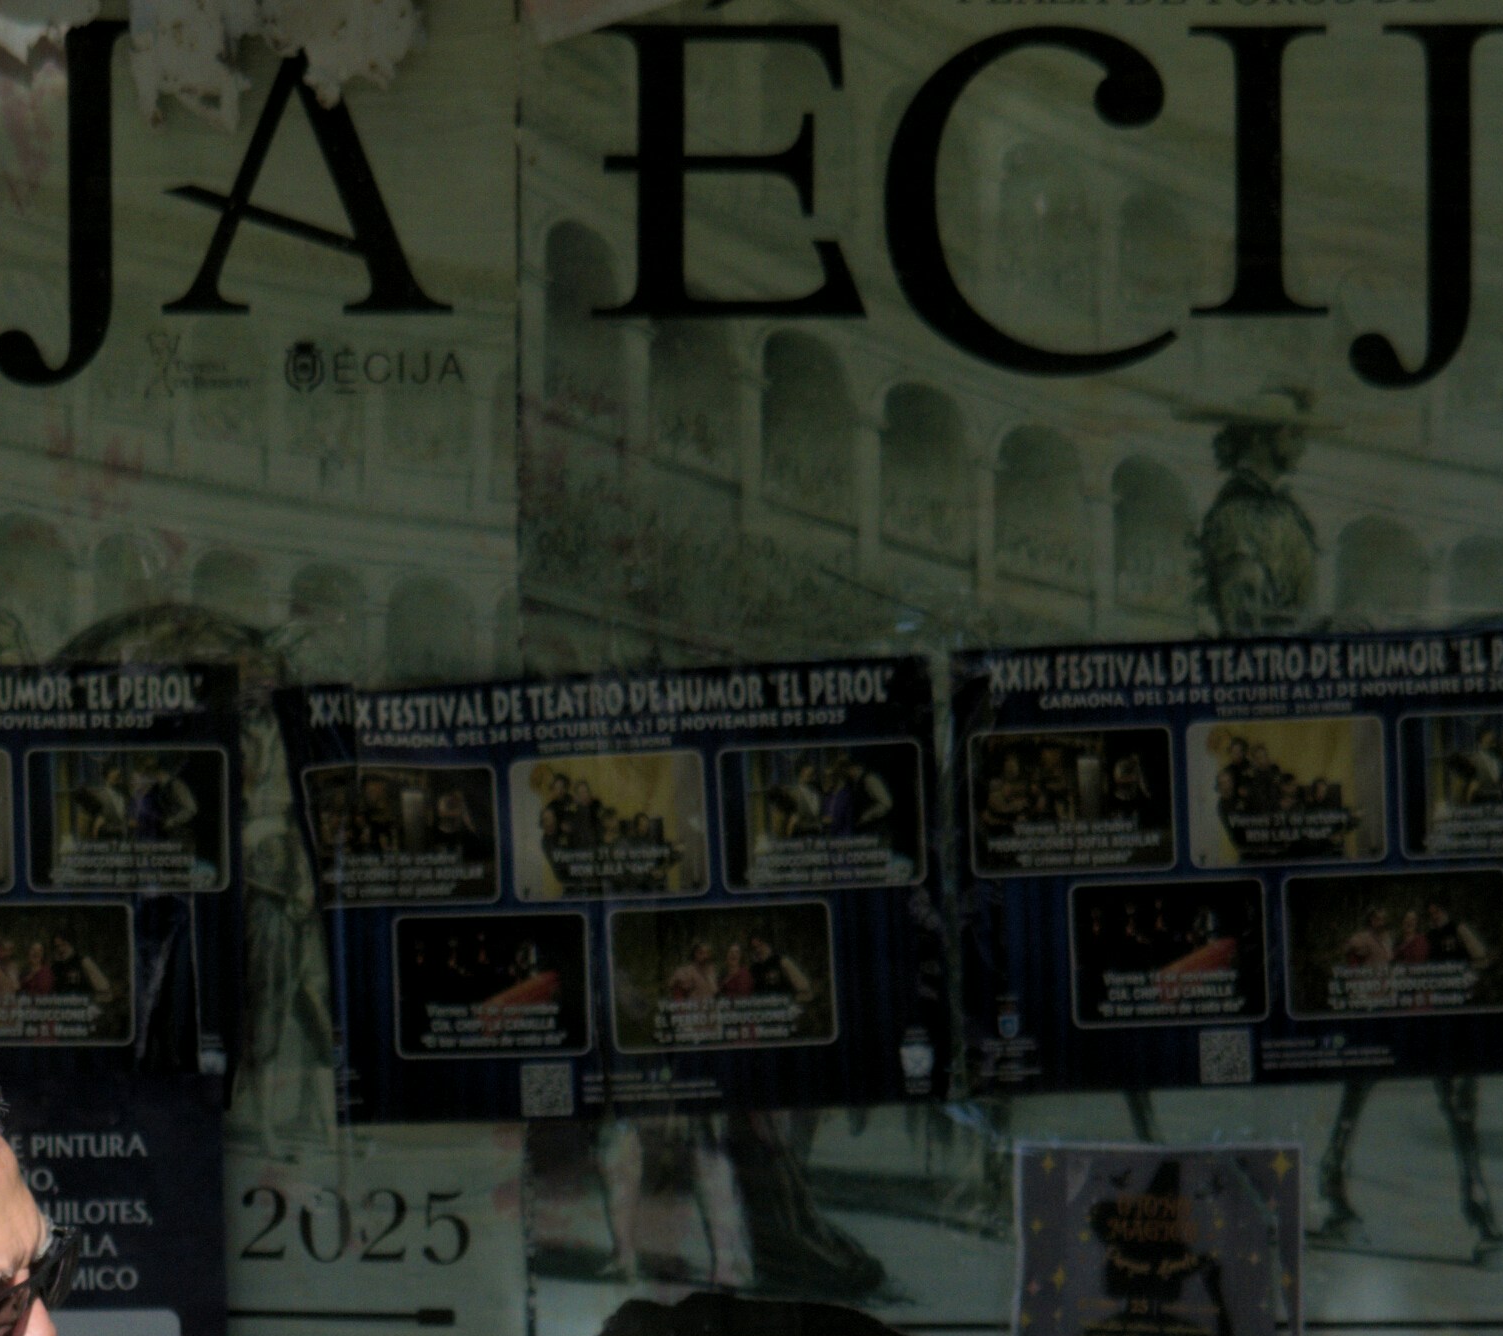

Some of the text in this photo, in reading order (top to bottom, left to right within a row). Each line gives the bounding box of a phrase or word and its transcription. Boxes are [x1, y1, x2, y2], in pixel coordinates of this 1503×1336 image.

[1055, 654, 1168, 691] FESTIVAL
[1172, 652, 1202, 685] DE
[1206, 646, 1304, 684] TEATRO
[1308, 644, 1341, 678] DE
[1347, 643, 1446, 677] HUMOR
[377, 675, 762, 732] FESTIVAL TEATRO HUMOR
[31, 1133, 148, 1159] PINTURA
[240, 1186, 471, 1265] 2025
